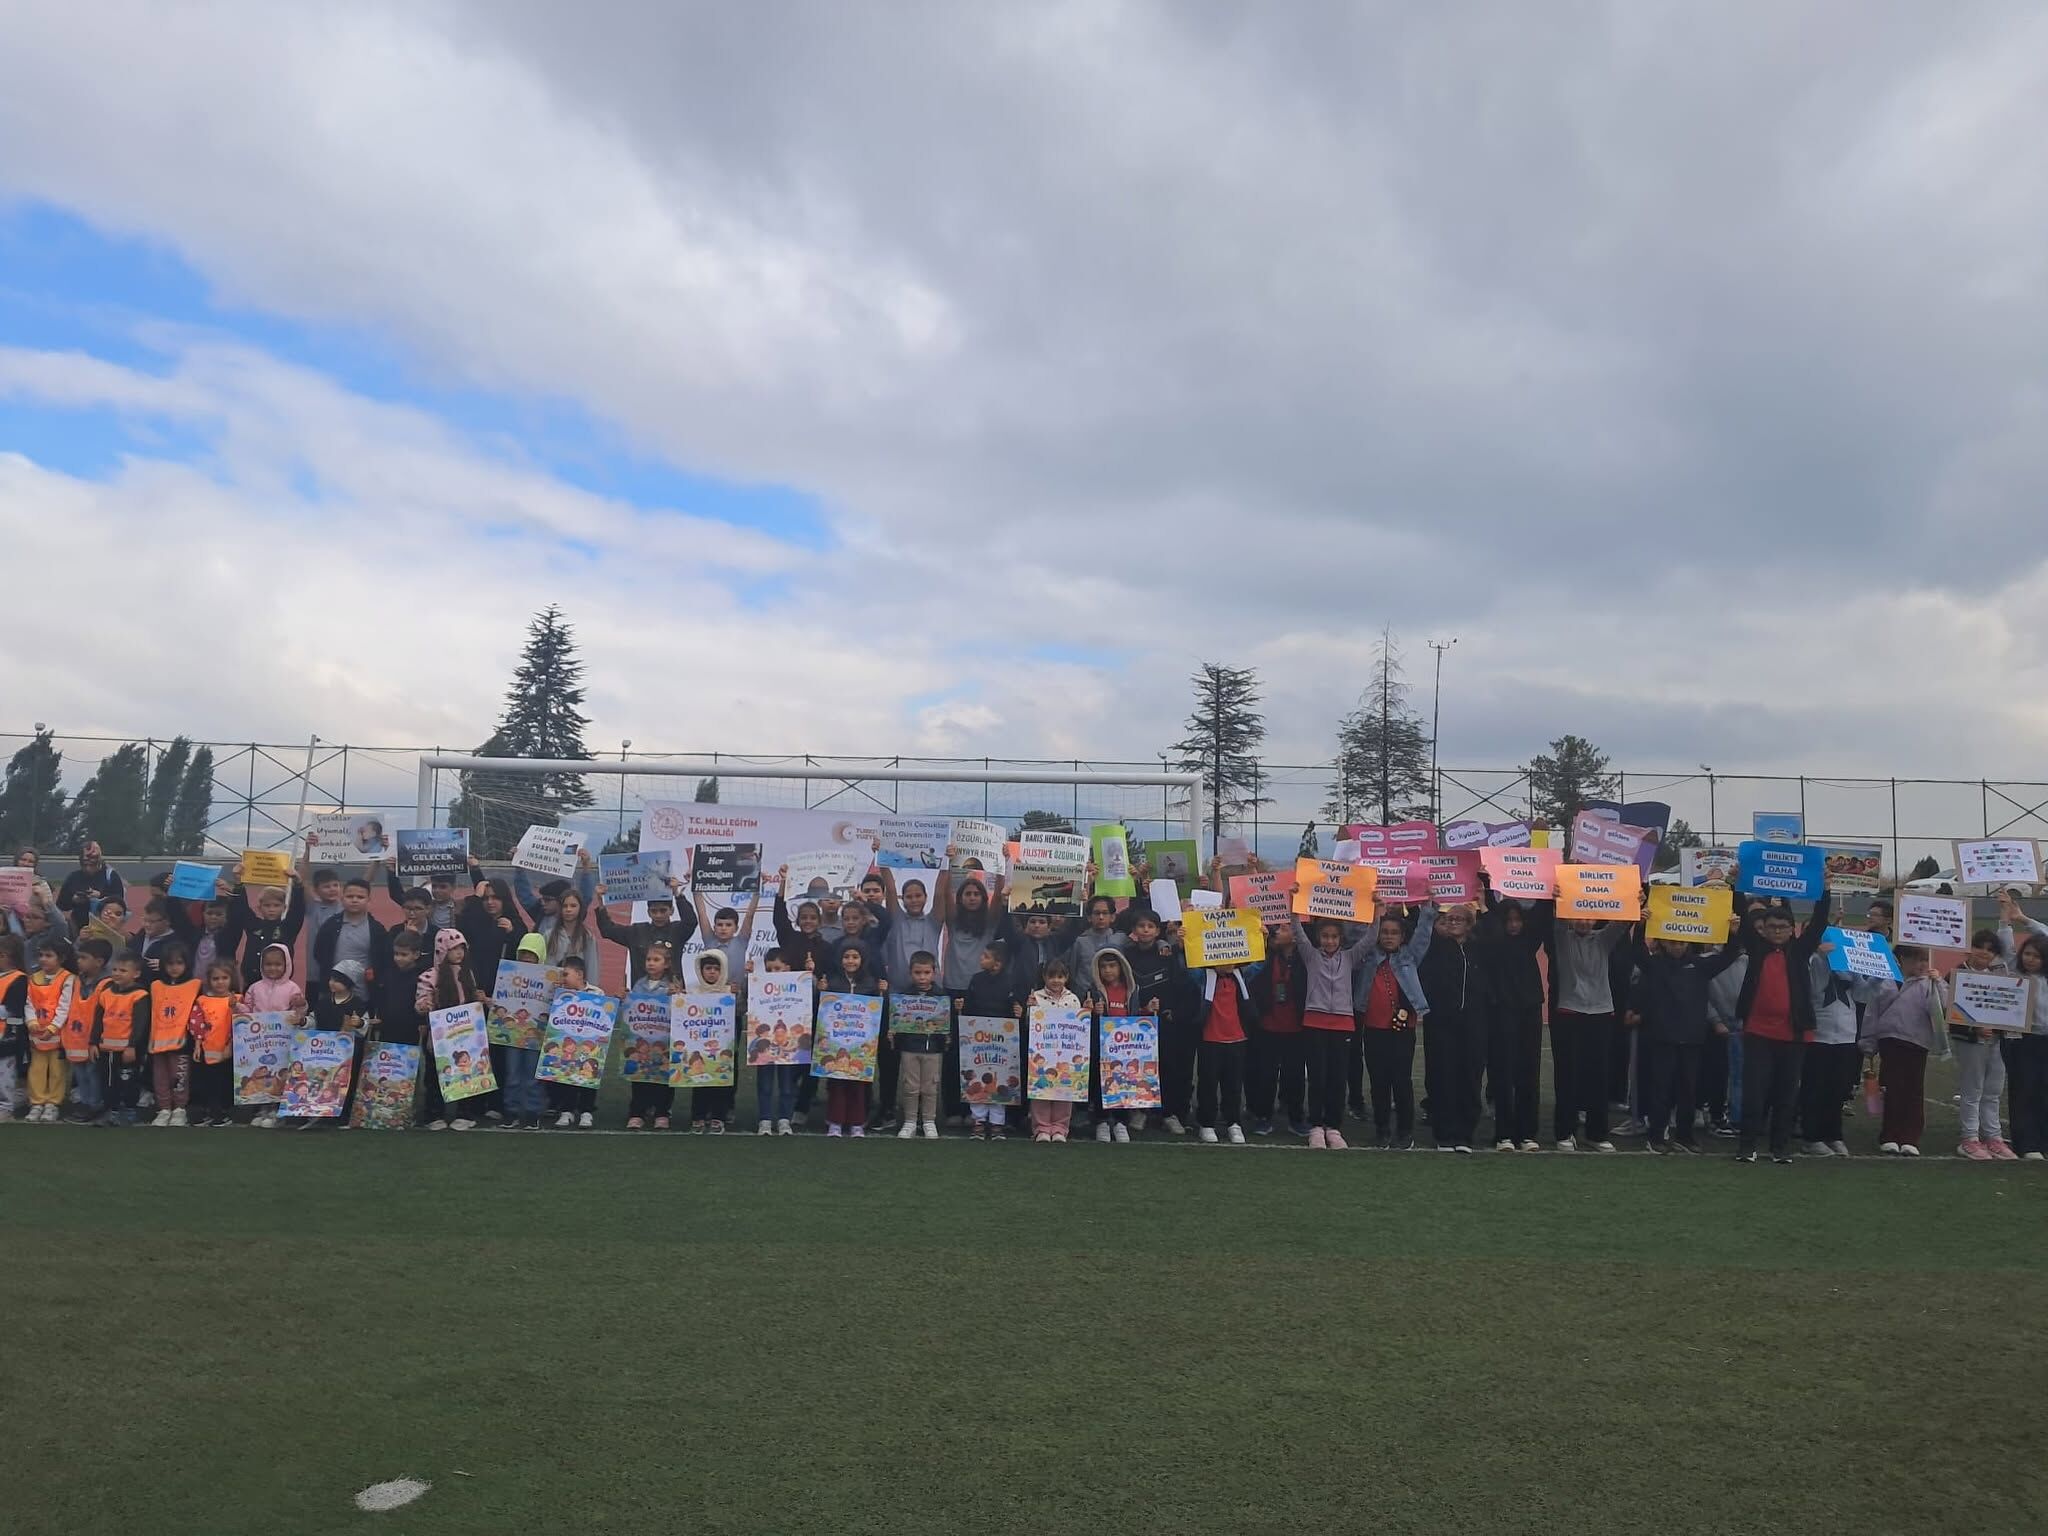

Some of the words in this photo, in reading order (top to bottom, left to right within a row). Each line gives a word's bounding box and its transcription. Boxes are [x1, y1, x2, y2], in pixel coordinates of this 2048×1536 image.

[314, 839, 351, 847] ombalar
[412, 853, 454, 861] GELECEK
[707, 857, 724, 865] Her
[1504, 854, 1537, 864] BİRLİKTE
[1766, 853, 1799, 862] BİRLİKTE
[400, 864, 464, 873] KARARMASIN!
[1320, 861, 1350, 873] YAŞAM
[1768, 866, 1793, 874] DAHA
[1428, 873, 1452, 881] DAHA
[1511, 869, 1534, 877] DAHA
[1579, 871, 1614, 880] BİRLİKTE
[1249, 874, 1276, 884] YAŞAM
[1329, 875, 1341, 883] VE
[1757, 878, 1804, 890] GÜÇLÜYÜZ
[1259, 884, 1269, 892] VE
[1314, 885, 1354, 898] GÜVENLİK
[1435, 885, 1463, 895] LÜYÜZ
[1503, 881, 1545, 891] GÜÇLÜYÜZ
[1248, 893, 1285, 903] GÜVENLİK
[1312, 897, 1351, 908] HAKKININ
[1671, 893, 1706, 905] BİRLİKTE
[1576, 899, 1621, 910] GÜÇLÜYÜZ
[1204, 910, 1236, 921] YAŞAM
[1309, 905, 1355, 918] TANITILMASI
[1675, 909, 1699, 918] DAHA
[1216, 920, 1227, 928] VE
[1665, 923, 1709, 934] GÜÇLÜYÜZ
[1204, 929, 1244, 940] GÜVENLİK
[1206, 940, 1244, 951] HAKKININ
[1204, 951, 1250, 961] TANITILMASI
[511, 975, 545, 990] Oyun
[764, 982, 797, 996] Oyun
[566, 1003, 601, 1018] Oyun
[638, 1002, 666, 1014] Oyun
[687, 1004, 722, 1017] Oyun
[445, 1009, 469, 1023] Oyun
[250, 1021, 282, 1034] Oyun
[552, 1016, 611, 1032] Geleceğimizdir
[683, 1017, 726, 1028] çocuğun
[974, 1029, 1005, 1044] Oyun
[1114, 1030, 1144, 1043] Oyun
[310, 1037, 336, 1048] Oyun
